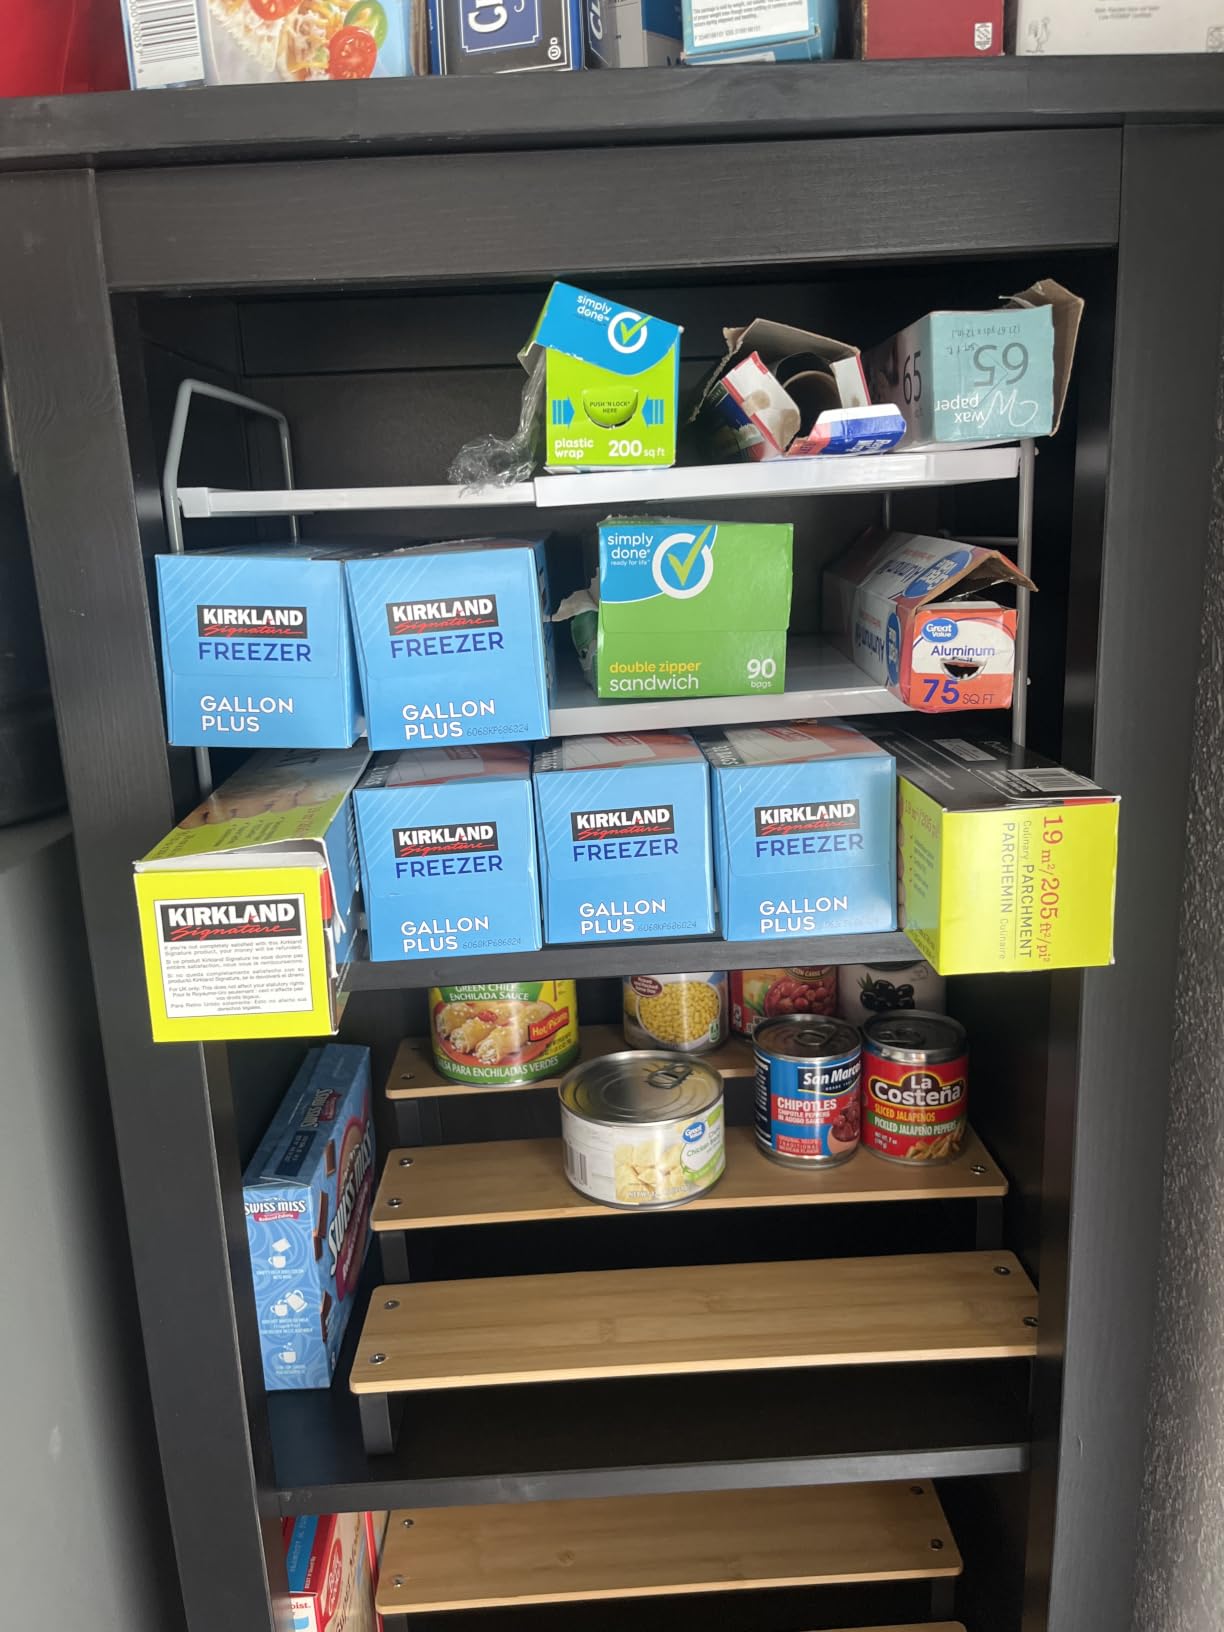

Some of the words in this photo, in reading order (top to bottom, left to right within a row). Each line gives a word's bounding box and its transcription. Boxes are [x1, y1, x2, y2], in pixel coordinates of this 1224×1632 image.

[577, 294, 612, 314] simply
[974, 342, 1029, 387] 65
[903, 350, 922, 405] 65
[935, 392, 979, 411] paper
[954, 410, 985, 423] wax
[555, 438, 594, 450] plastic
[608, 440, 642, 457] 200
[644, 449, 655, 458] sq
[657, 448, 665, 456] ft
[555, 449, 584, 460] wrap
[608, 532, 653, 547] simply
[203, 608, 303, 625] KIRKLAND
[392, 599, 493, 622] KIRKLAND
[203, 624, 304, 637] Signature
[394, 618, 496, 634] Signature
[926, 624, 952, 632] Great
[199, 642, 312, 662] FREEZER
[391, 631, 504, 659] FREEZER
[931, 645, 995, 656] Aluminum
[609, 662, 656, 673] double
[659, 661, 701, 675] zipper
[747, 658, 776, 679] 90
[610, 674, 699, 692] sandwich
[751, 680, 771, 688] bags
[923, 679, 959, 704] 75
[963, 694, 980, 704] SQ
[982, 694, 994, 704] FT
[200, 696, 294, 714] GALLON
[402, 699, 495, 721] GALLON
[202, 716, 260, 732] PLUS
[405, 721, 463, 741] PLUS
[577, 808, 670, 829] KIRKLAND
[761, 804, 856, 825] KIRKLAND
[398, 825, 493, 846] KIRKLAND
[578, 825, 671, 840] Signature
[1043, 816, 1063, 844] 19
[400, 842, 495, 857] Signature
[756, 834, 864, 858] FREEZER
[1021, 820, 1032, 861] Culinary
[573, 838, 678, 862] FREEZER
[396, 855, 503, 878] FREEZER
[1001, 823, 1015, 913] PARCHEMIN
[168, 903, 295, 926] KIRKLAND
[579, 899, 666, 917] GALLON
[760, 896, 848, 916] GALLON
[1020, 865, 1034, 958] PARCHMENT
[171, 924, 297, 941] Signature
[401, 916, 489, 936] GALLON
[581, 919, 634, 935] PLUS
[761, 916, 816, 934] PLUS
[403, 936, 458, 953] PLUS
[1000, 919, 1008, 959] Culinaire
[450, 992, 497, 1001] ENCHILADA
[499, 991, 528, 1000] SAUCE
[456, 984, 485, 992] GREEN
[452, 1064, 471, 1076] PARA
[473, 1064, 527, 1077] ENCHILADAS
[529, 1056, 559, 1072] VERDES
[803, 1072, 829, 1085] San
[911, 1076, 932, 1089] La
[875, 1081, 960, 1105] Costeña
[777, 1096, 837, 1112] CHIPOTLES
[875, 1103, 895, 1118] SLICED
[874, 1116, 898, 1132] PICKLED
[934, 1120, 956, 1134] PEPPERS
[244, 1202, 276, 1216] SWISS
[278, 1200, 306, 1213] MISS
